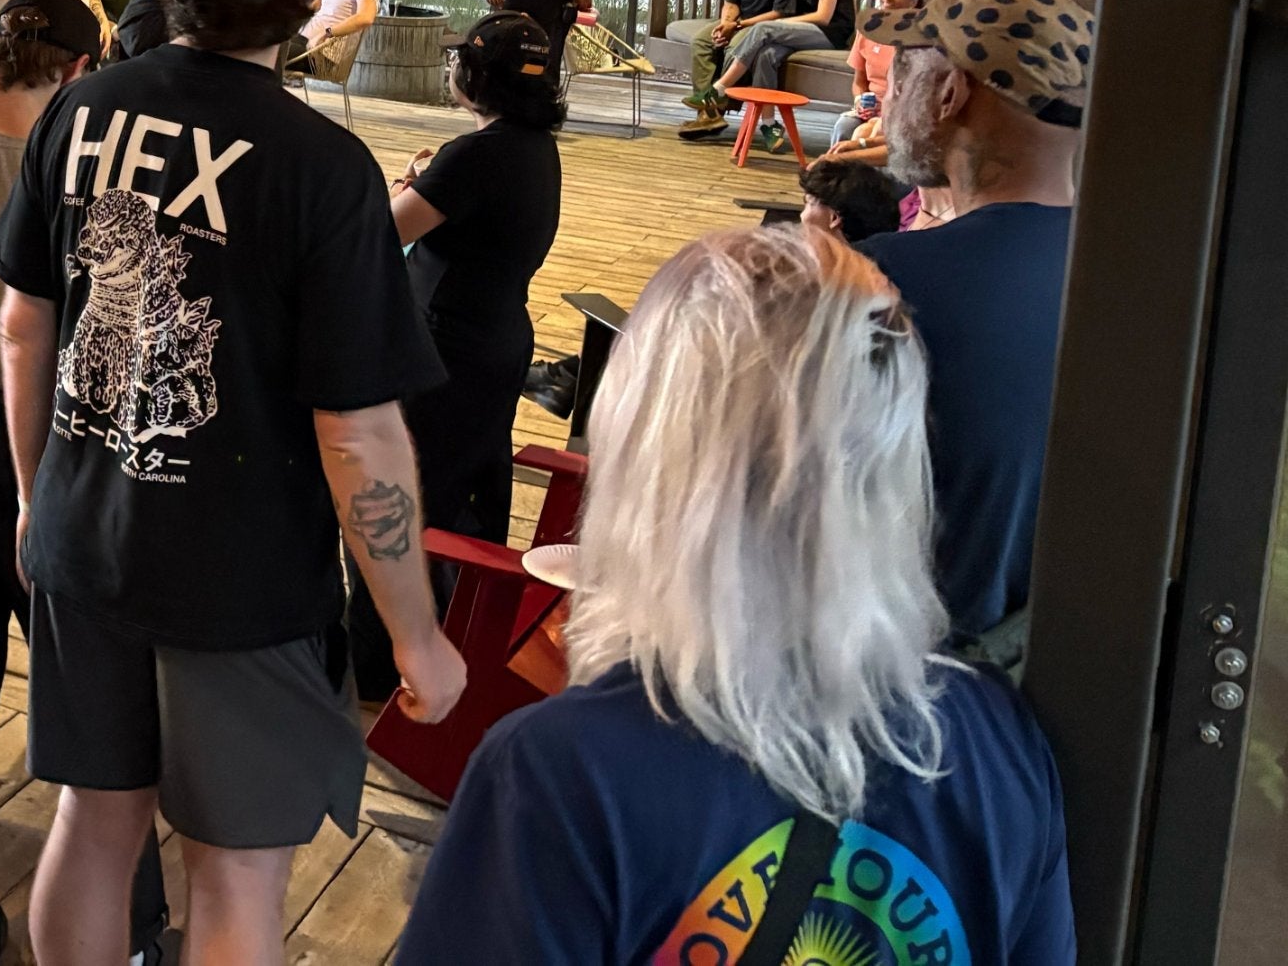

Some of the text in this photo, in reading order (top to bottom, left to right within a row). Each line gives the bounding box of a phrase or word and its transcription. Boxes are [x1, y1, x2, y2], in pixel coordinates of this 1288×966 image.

[65, 106, 254, 233] HEX
[179, 223, 227, 246] ROASTERS
[138, 472, 186, 484] CAROLINA
[680, 840, 953, 966] OVE OUR
